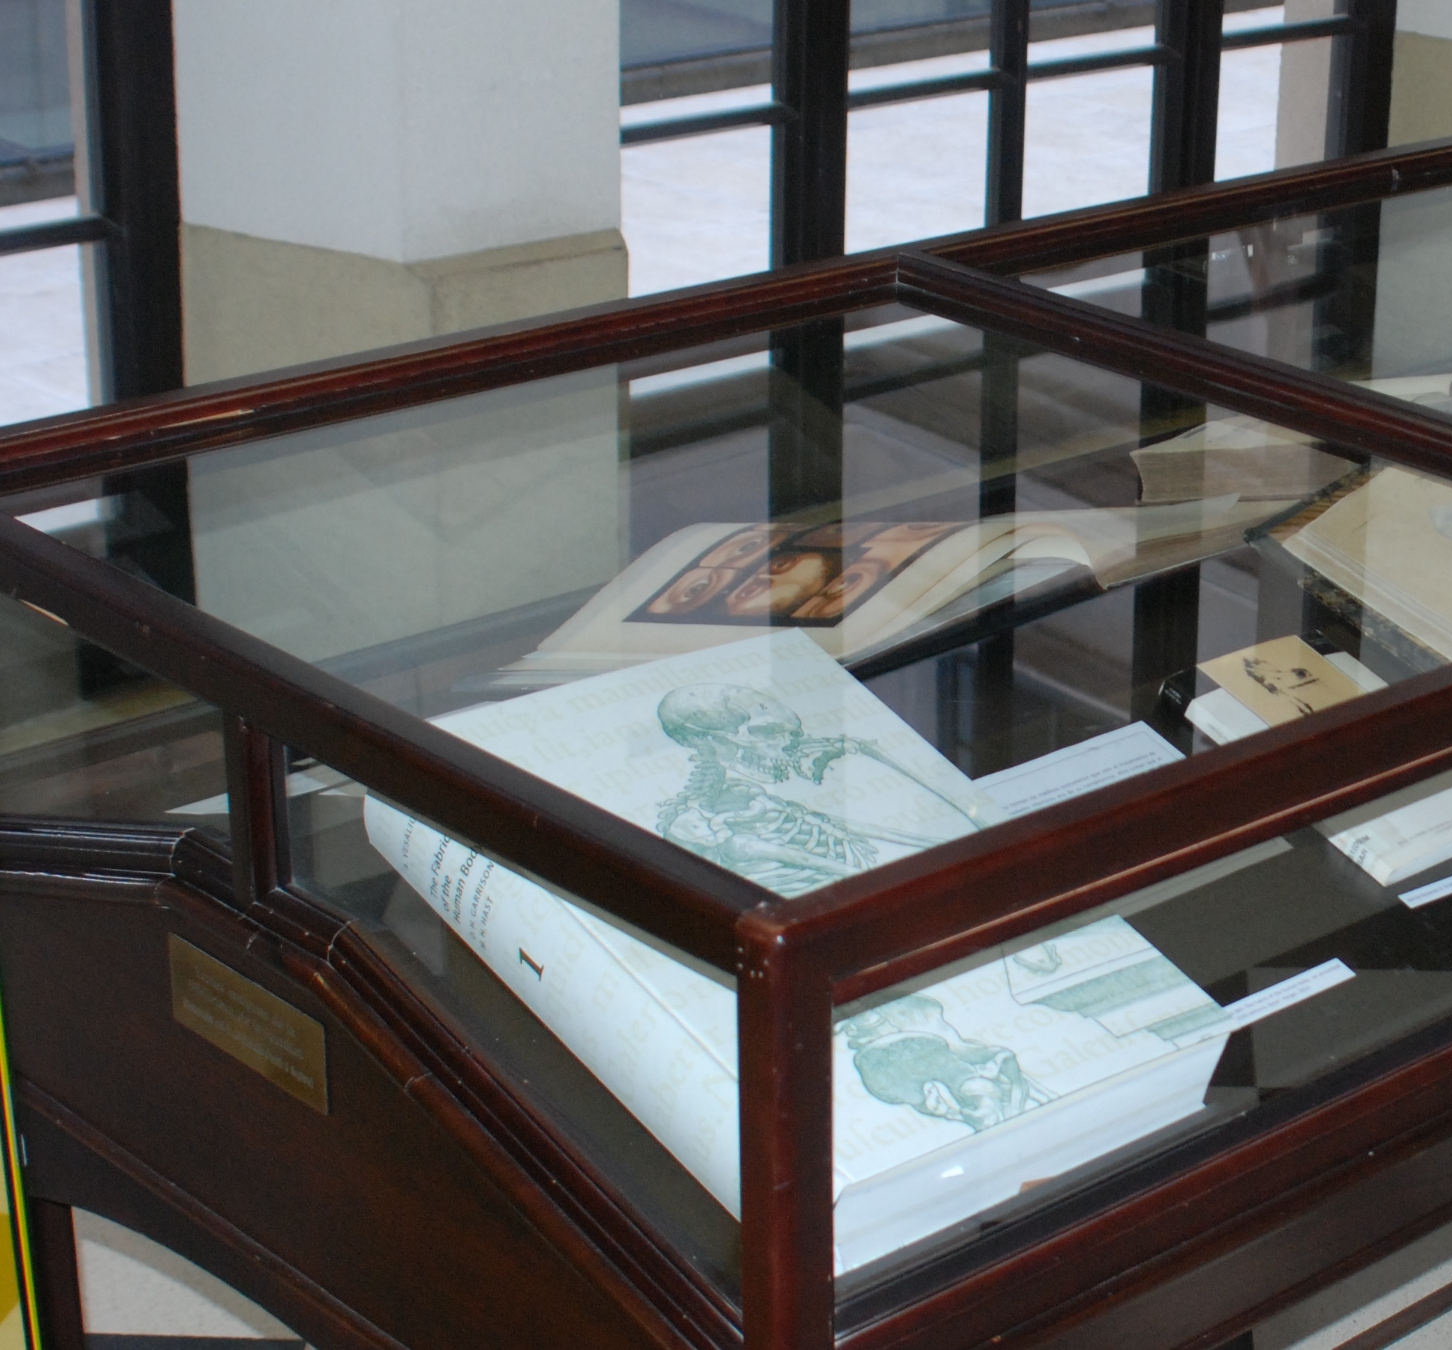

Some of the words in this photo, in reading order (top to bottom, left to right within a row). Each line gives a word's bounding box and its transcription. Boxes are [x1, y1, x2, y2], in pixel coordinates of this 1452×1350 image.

[402, 817, 416, 858] VESALIU
[431, 834, 451, 876] Fabric
[429, 877, 439, 899] The
[441, 894, 450, 912] of
[442, 875, 452, 897] the
[453, 878, 466, 924] Human
[470, 859, 495, 918] GARRISON
[480, 895, 493, 926] HAST
[519, 947, 545, 982] 1
